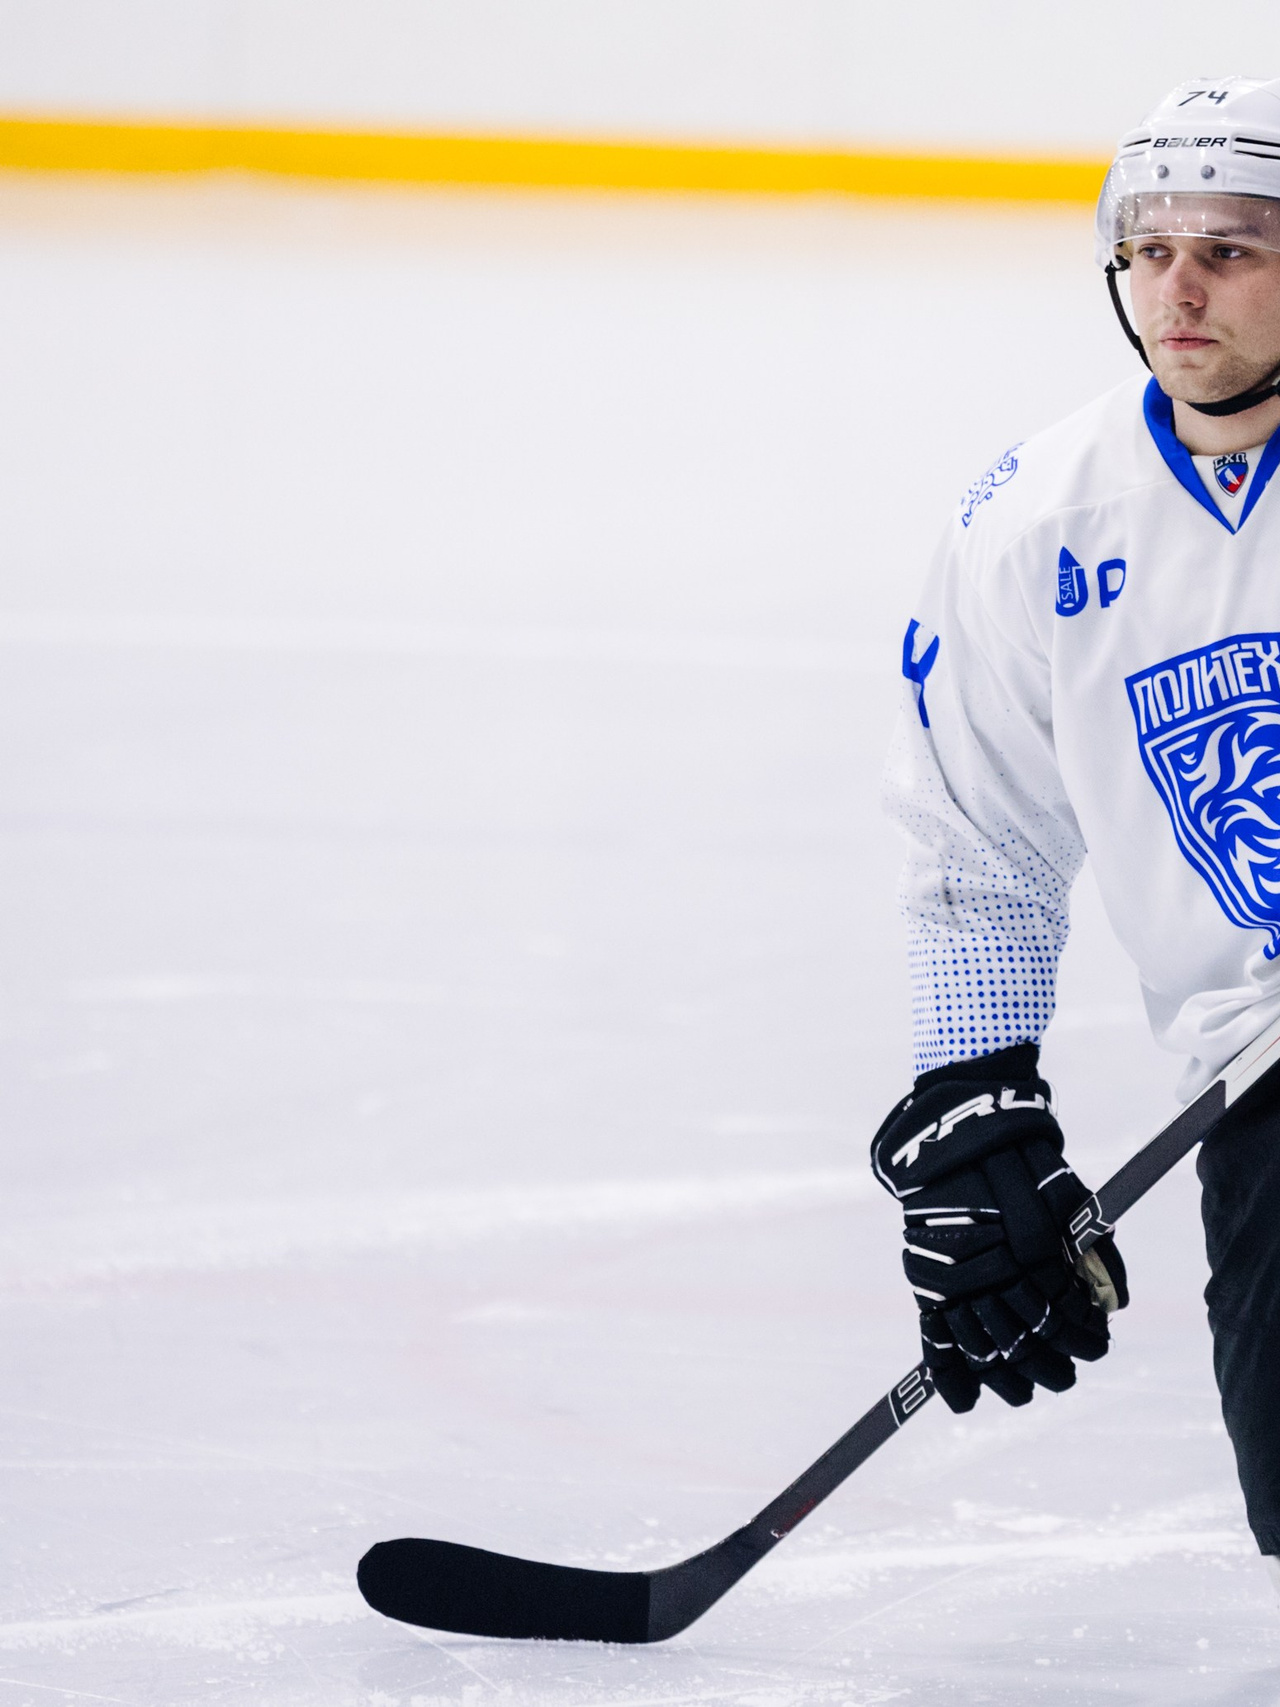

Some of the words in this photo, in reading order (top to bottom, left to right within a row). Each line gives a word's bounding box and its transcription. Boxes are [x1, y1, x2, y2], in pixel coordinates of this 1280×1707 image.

[1178, 91, 1229, 107] 74
[1058, 566, 1074, 600] SALE
[891, 1087, 1050, 1168] TRU
